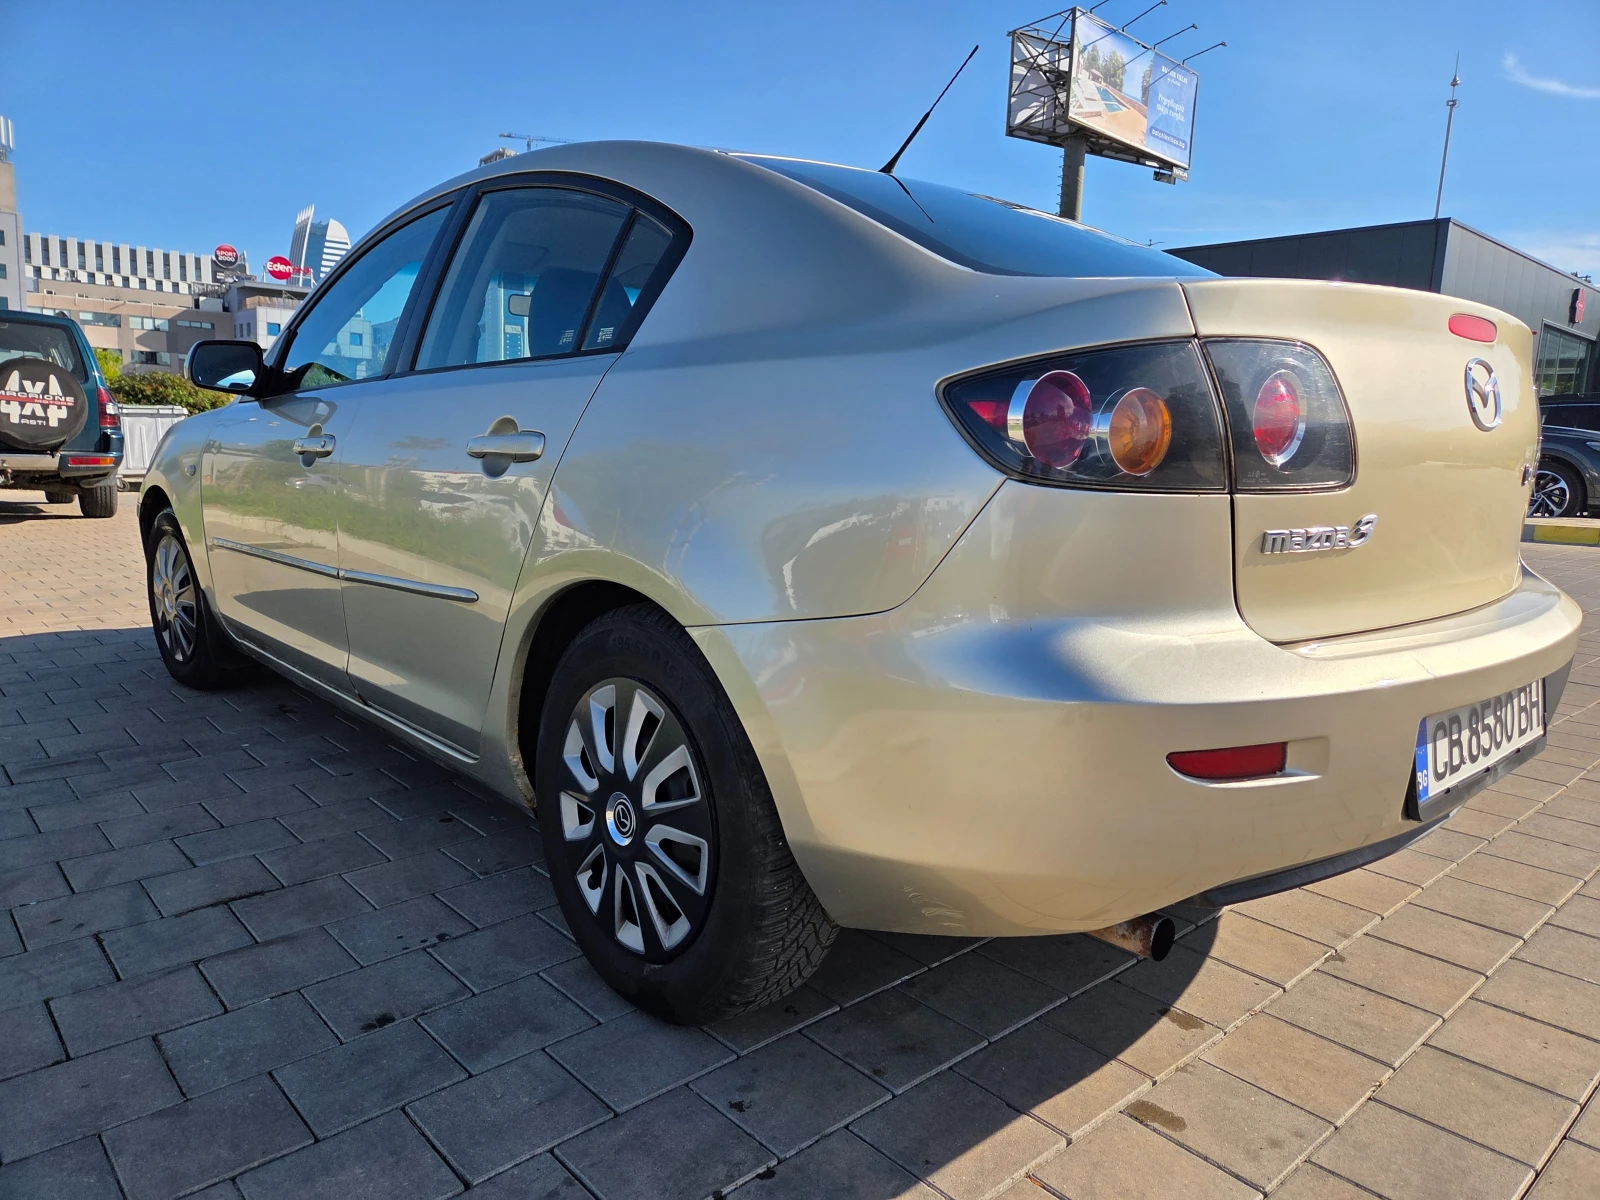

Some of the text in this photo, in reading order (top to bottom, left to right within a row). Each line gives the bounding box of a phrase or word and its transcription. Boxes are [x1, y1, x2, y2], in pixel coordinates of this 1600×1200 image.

[216, 250, 237, 258] SPORT
[21, 418, 46, 426] ASTI
[1467, 690, 1515, 765] 8580
